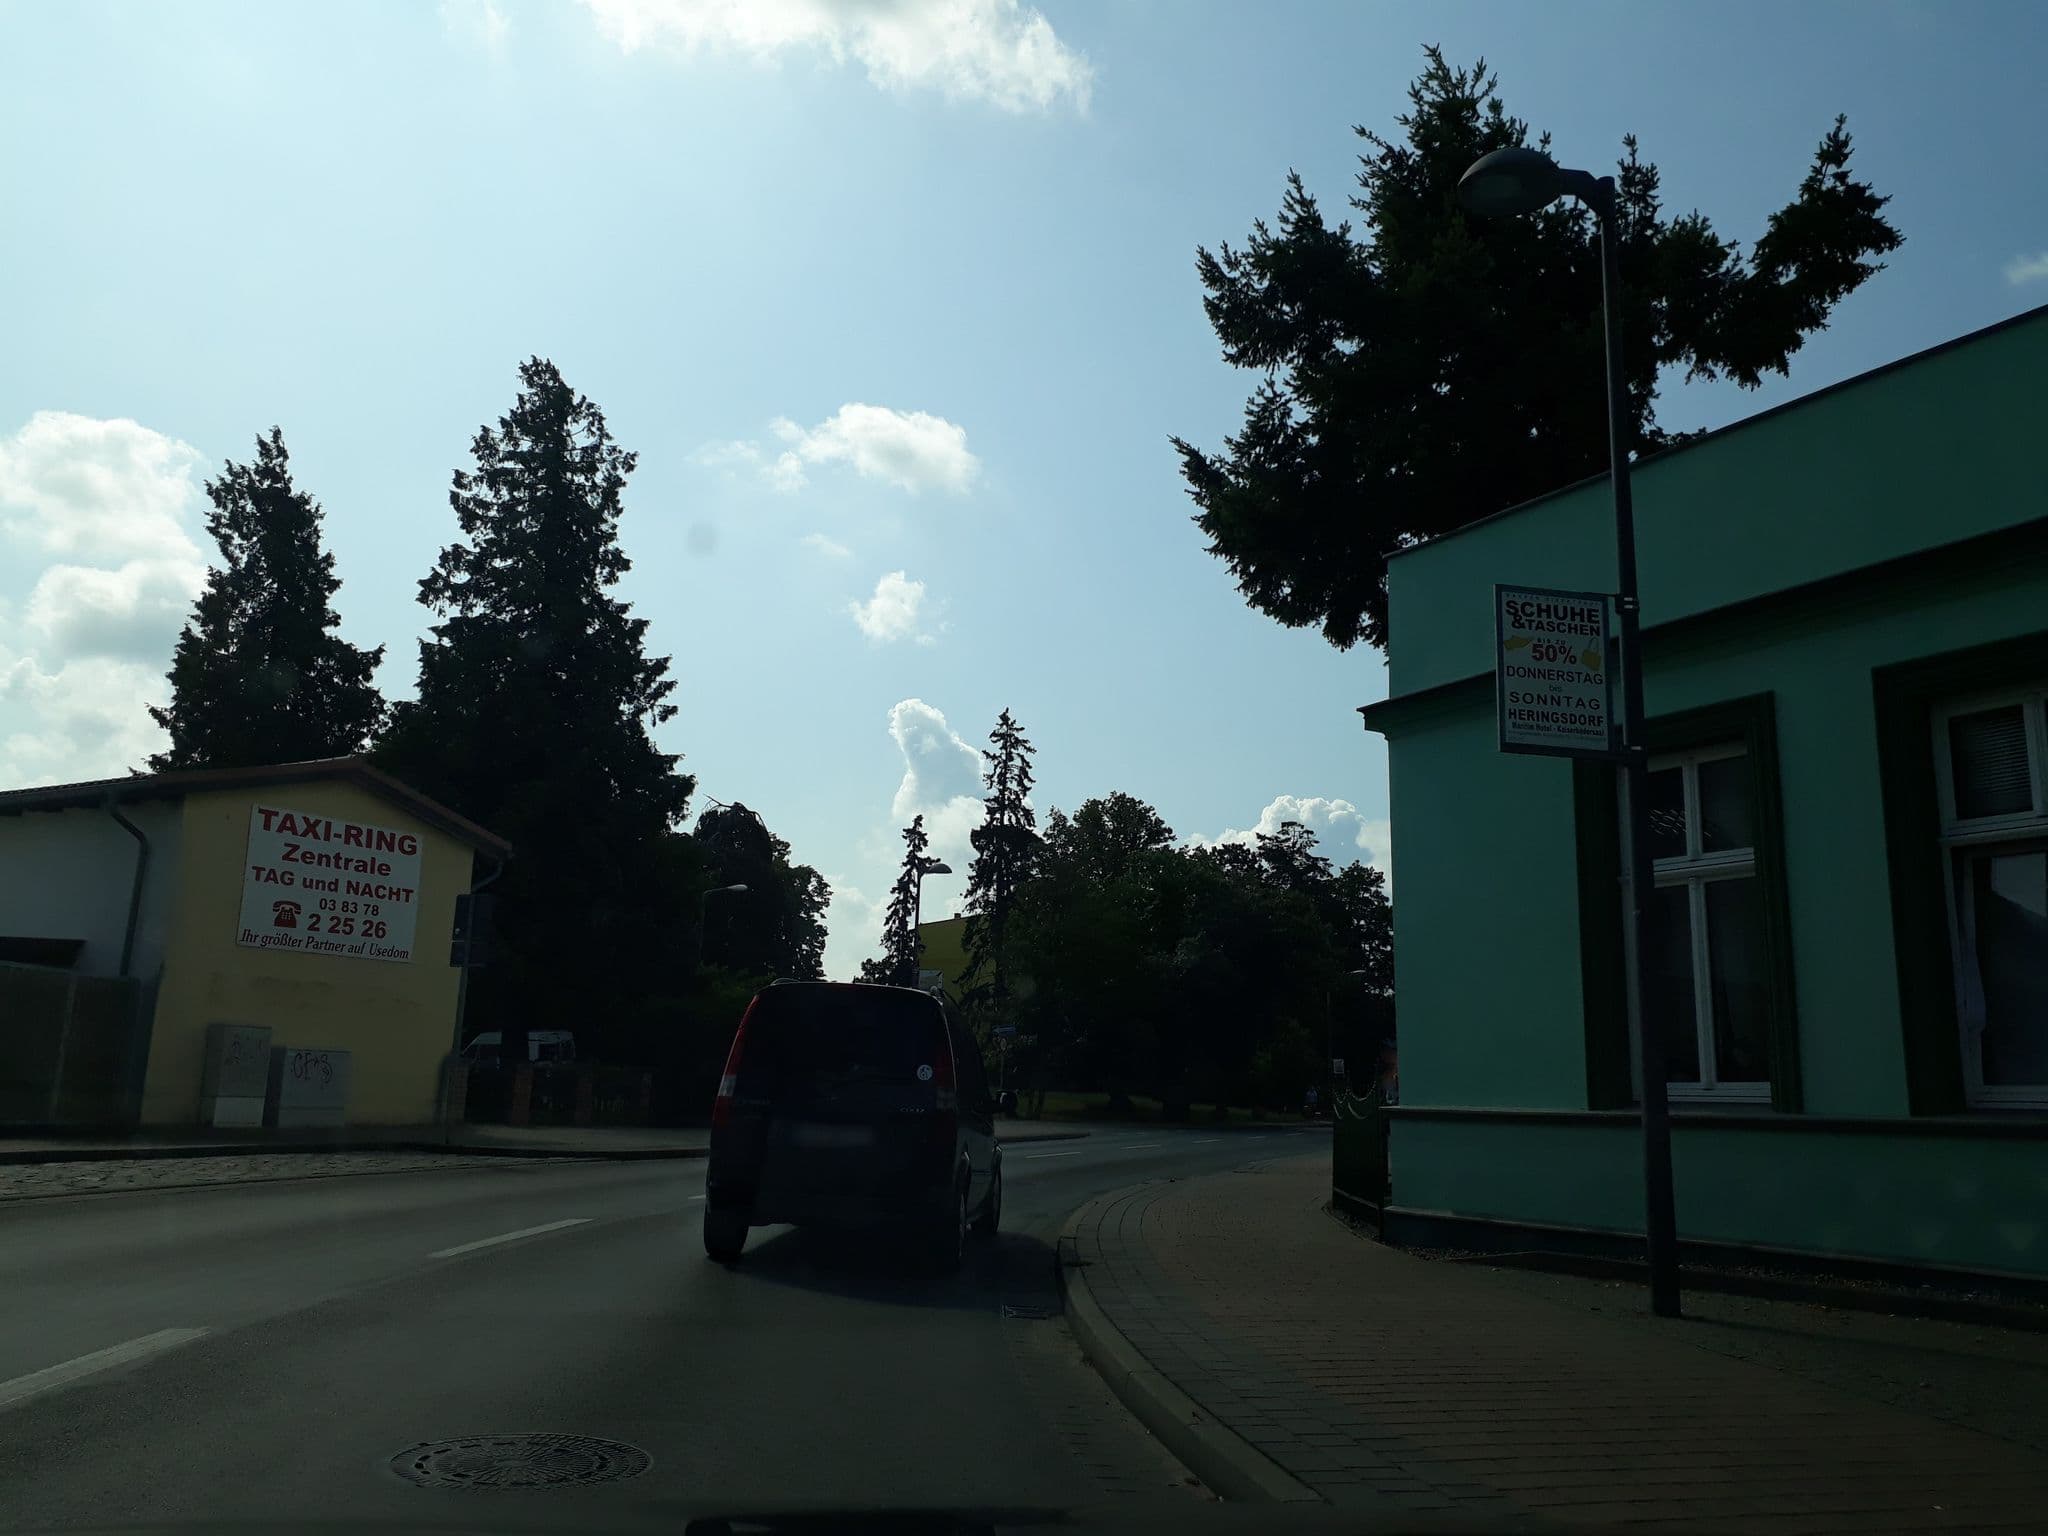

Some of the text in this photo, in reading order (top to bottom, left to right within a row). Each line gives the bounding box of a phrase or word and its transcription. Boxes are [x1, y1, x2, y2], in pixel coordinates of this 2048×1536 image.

[1505, 600, 1600, 624] SCHUHE
[1531, 643, 1577, 665] 50%
[1506, 665, 1604, 685] DONNERSTAG
[1509, 691, 1601, 710] SONNTAG
[1508, 708, 1604, 727] HERINGSDORF
[258, 807, 417, 855] TAXI-RING
[281, 842, 392, 877] Zentrale
[252, 865, 415, 903] TAG und NACHT
[319, 898, 379, 916] 03 83 78
[306, 913, 387, 939] 2 25 26
[240, 928, 409, 960] Ihr größter Partner auf Usedom
